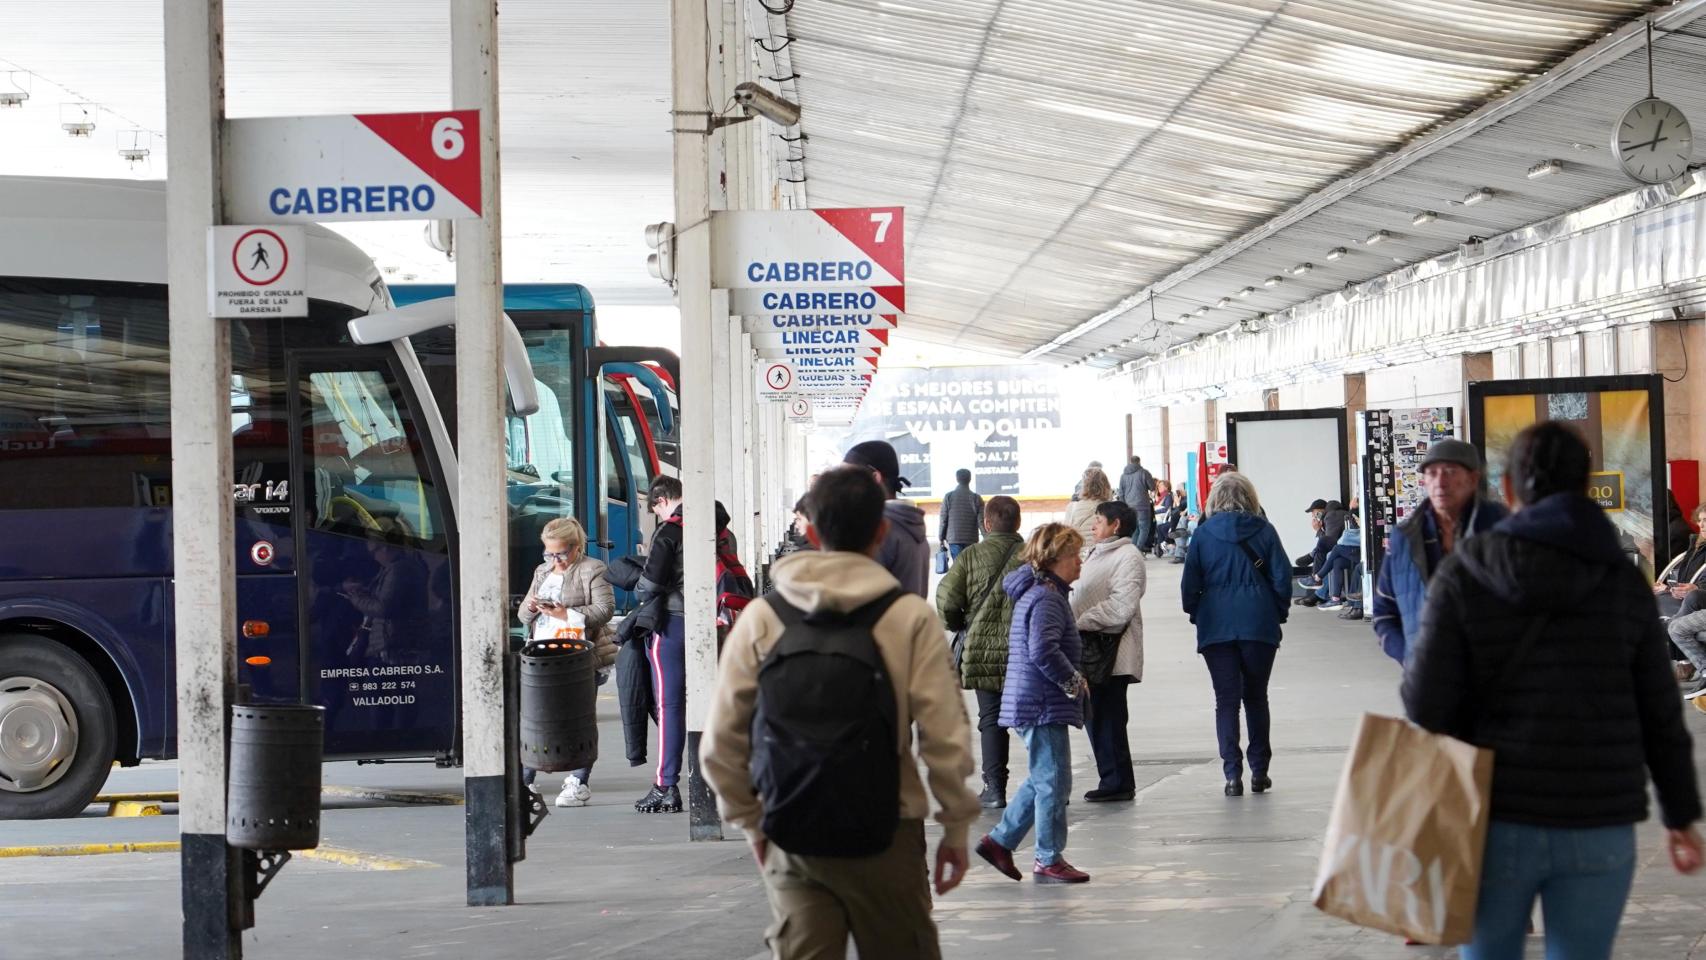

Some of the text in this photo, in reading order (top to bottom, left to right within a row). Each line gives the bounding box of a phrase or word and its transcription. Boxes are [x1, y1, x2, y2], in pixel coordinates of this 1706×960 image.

[431, 117, 465, 160] 6
[269, 184, 435, 215] CABRERO
[870, 212, 893, 243] 7
[747, 260, 873, 282] CABRERO
[217, 290, 261, 298] PROHIBIDO
[763, 291, 877, 310] CABRERO
[772, 314, 873, 328] CABRERO
[782, 330, 860, 345] LINECAR
[792, 357, 855, 367] INECAR
[914, 381, 993, 398] MEJORES
[896, 396, 965, 416] ESPAÑA
[968, 397, 1060, 415] COMPITEN
[900, 453, 922, 465] DEL
[922, 453, 931, 464] 2
[987, 451, 1002, 462] AL
[1003, 451, 1010, 461] 7
[234, 480, 289, 502] ar i4
[1588, 486, 1613, 499] ao
[320, 664, 445, 679] EMPRESA CABRERO S.A.
[362, 681, 416, 691] 983 222 574
[353, 695, 416, 706] VALLADOLID
